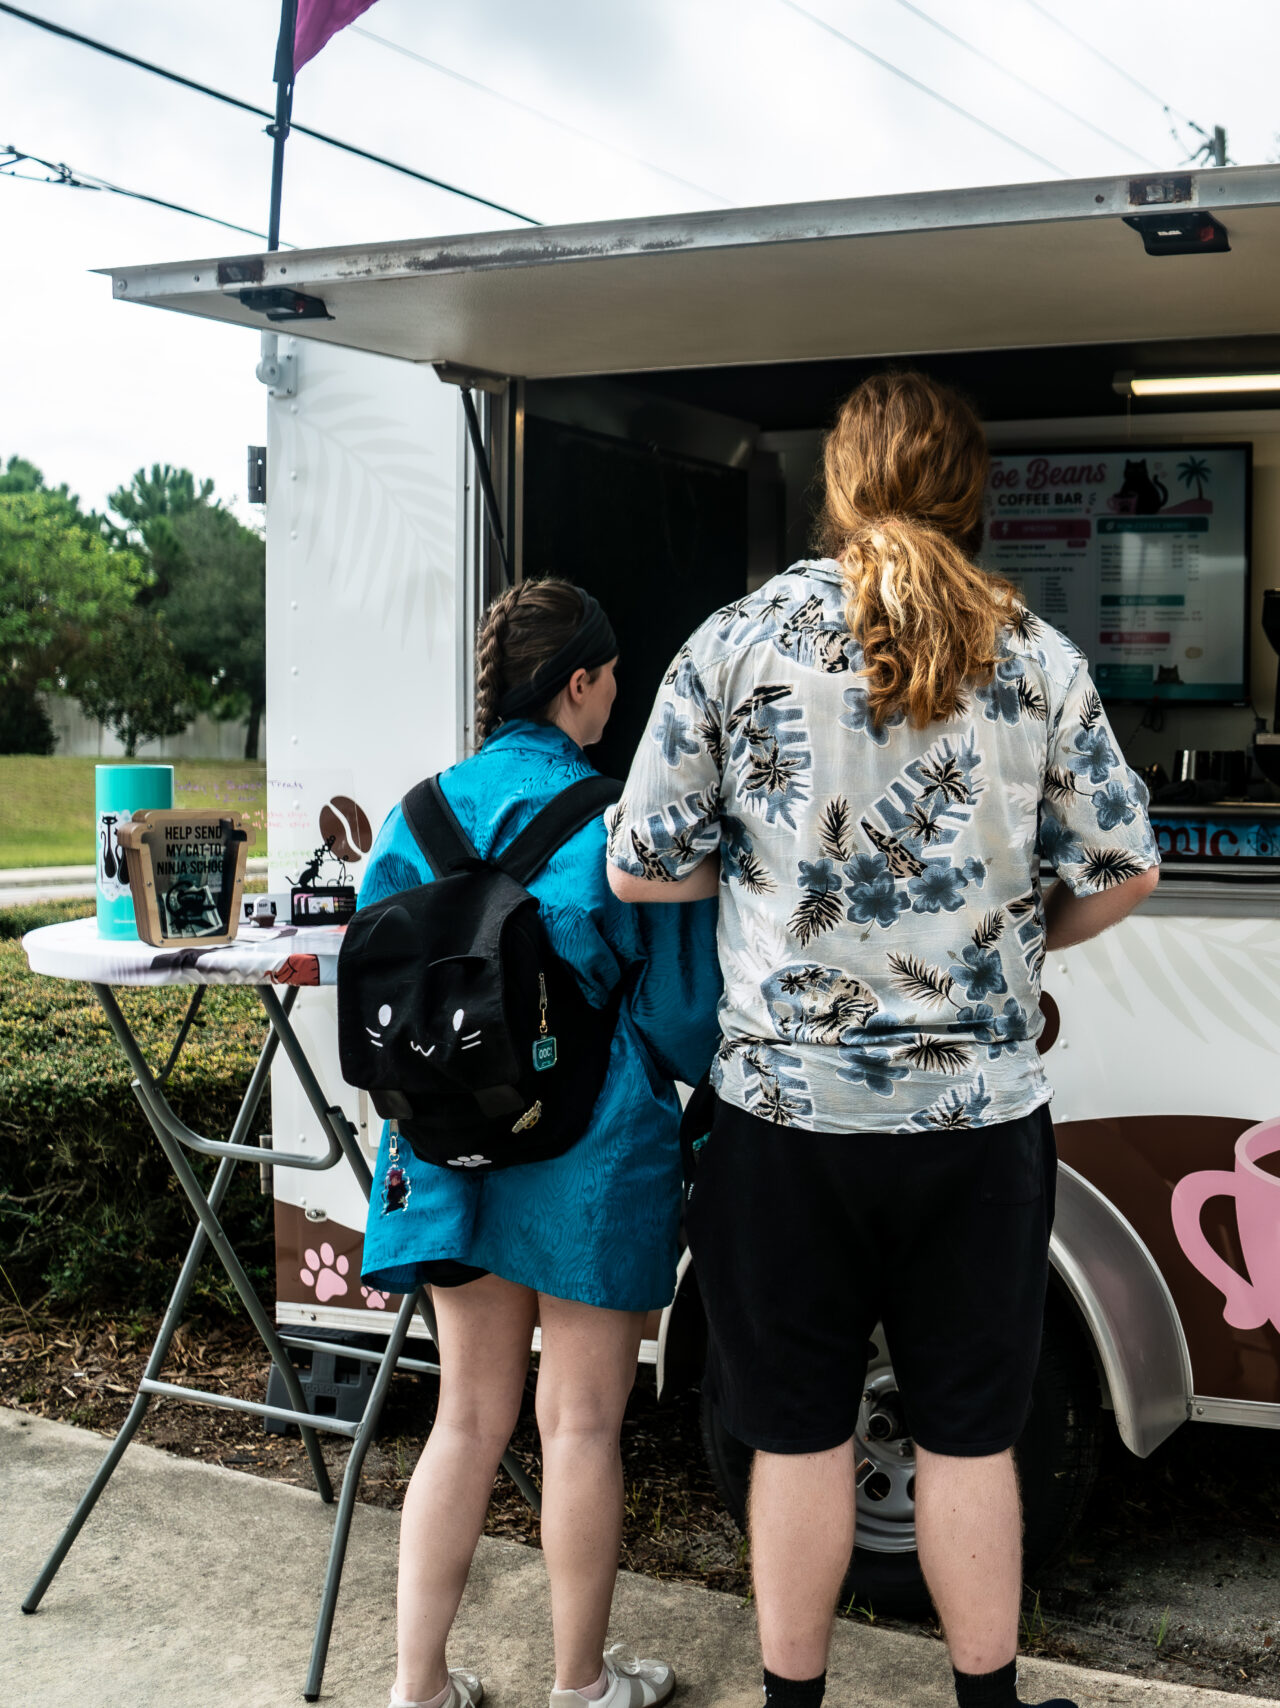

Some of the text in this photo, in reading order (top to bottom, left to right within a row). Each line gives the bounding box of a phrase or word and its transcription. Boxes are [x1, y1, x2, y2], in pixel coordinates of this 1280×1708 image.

[1026, 458, 1107, 490] Beans
[998, 491, 1082, 506] COFFEE BAR
[165, 825, 222, 840] HELP SEND
[166, 843, 222, 857] MY CAT TO
[157, 860, 225, 876] NINJA SCHOO
